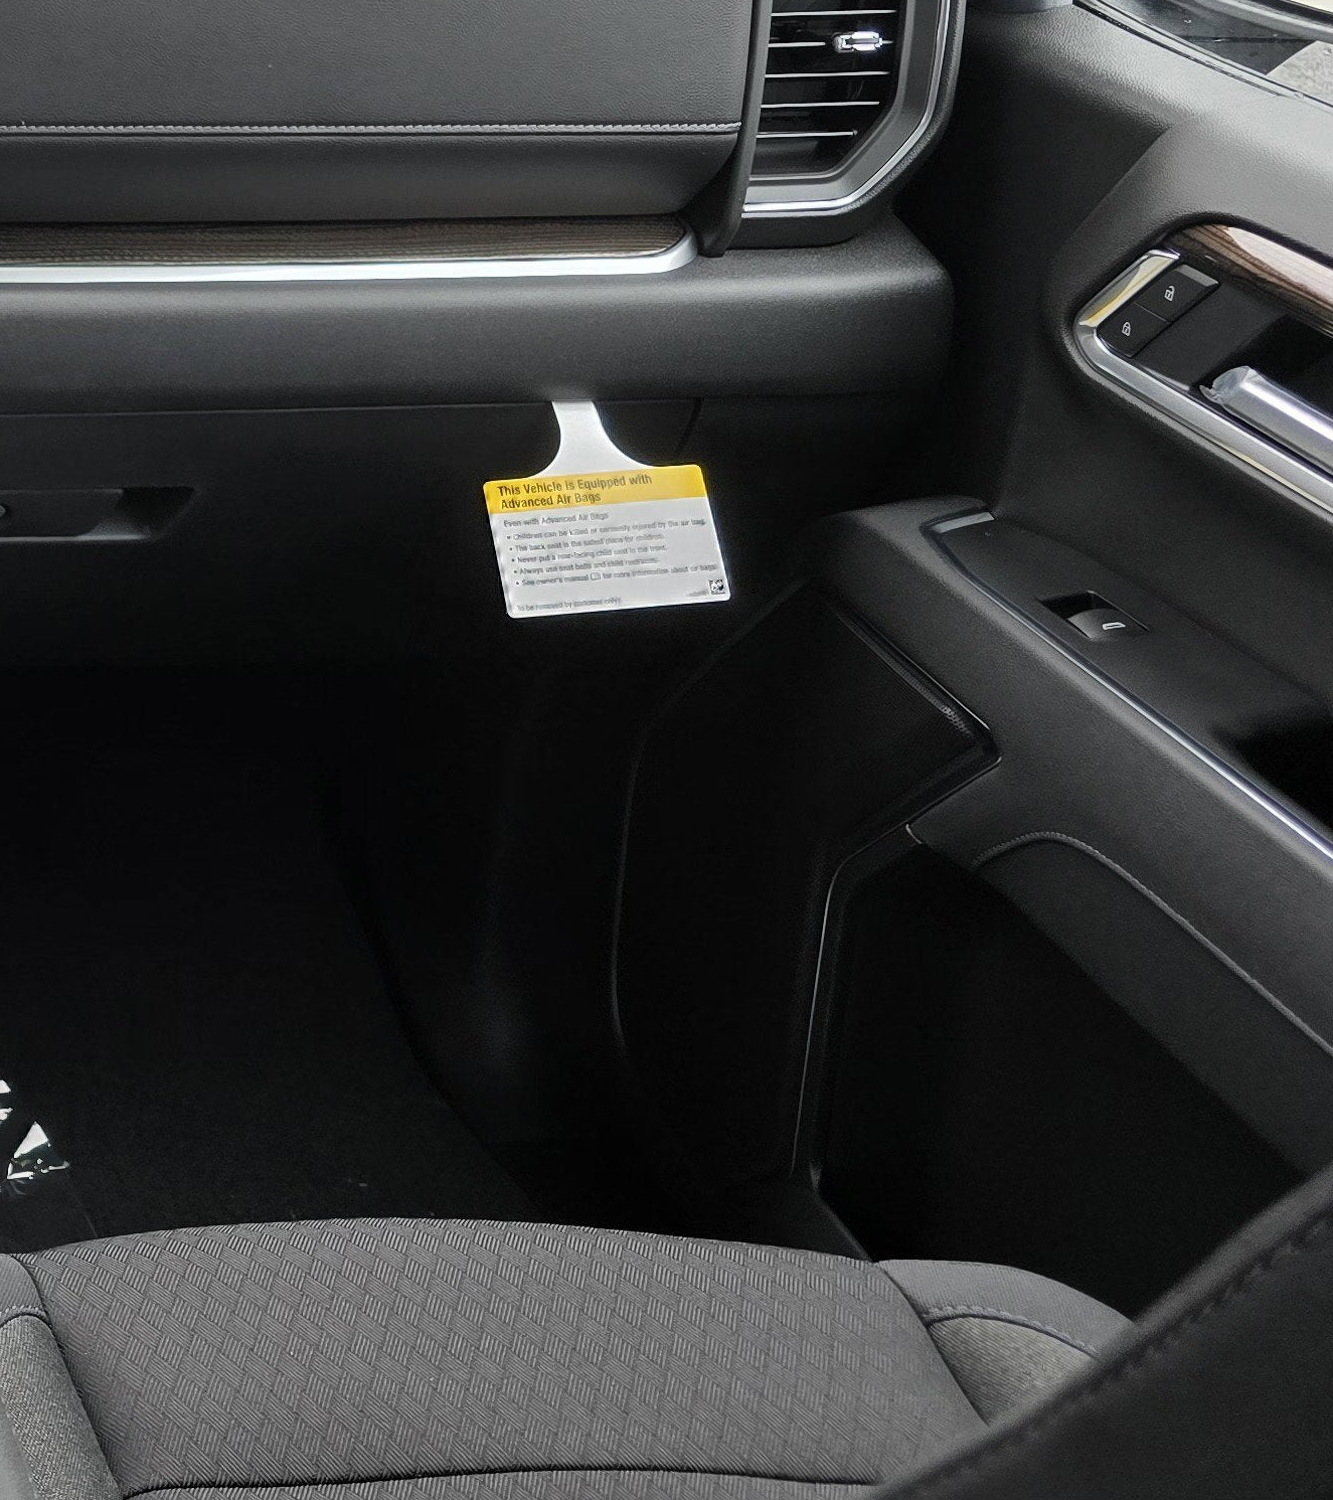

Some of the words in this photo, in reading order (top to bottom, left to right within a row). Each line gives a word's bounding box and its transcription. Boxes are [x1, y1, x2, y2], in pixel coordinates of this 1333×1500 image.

[497, 485, 521, 496] This
[523, 482, 563, 493] Vehicle
[565, 481, 575, 489] is
[577, 476, 627, 490] Equipped
[628, 473, 653, 484] with
[500, 496, 554, 509] Advanced
[555, 494, 572, 504] Air
[574, 492, 602, 504] Bags
